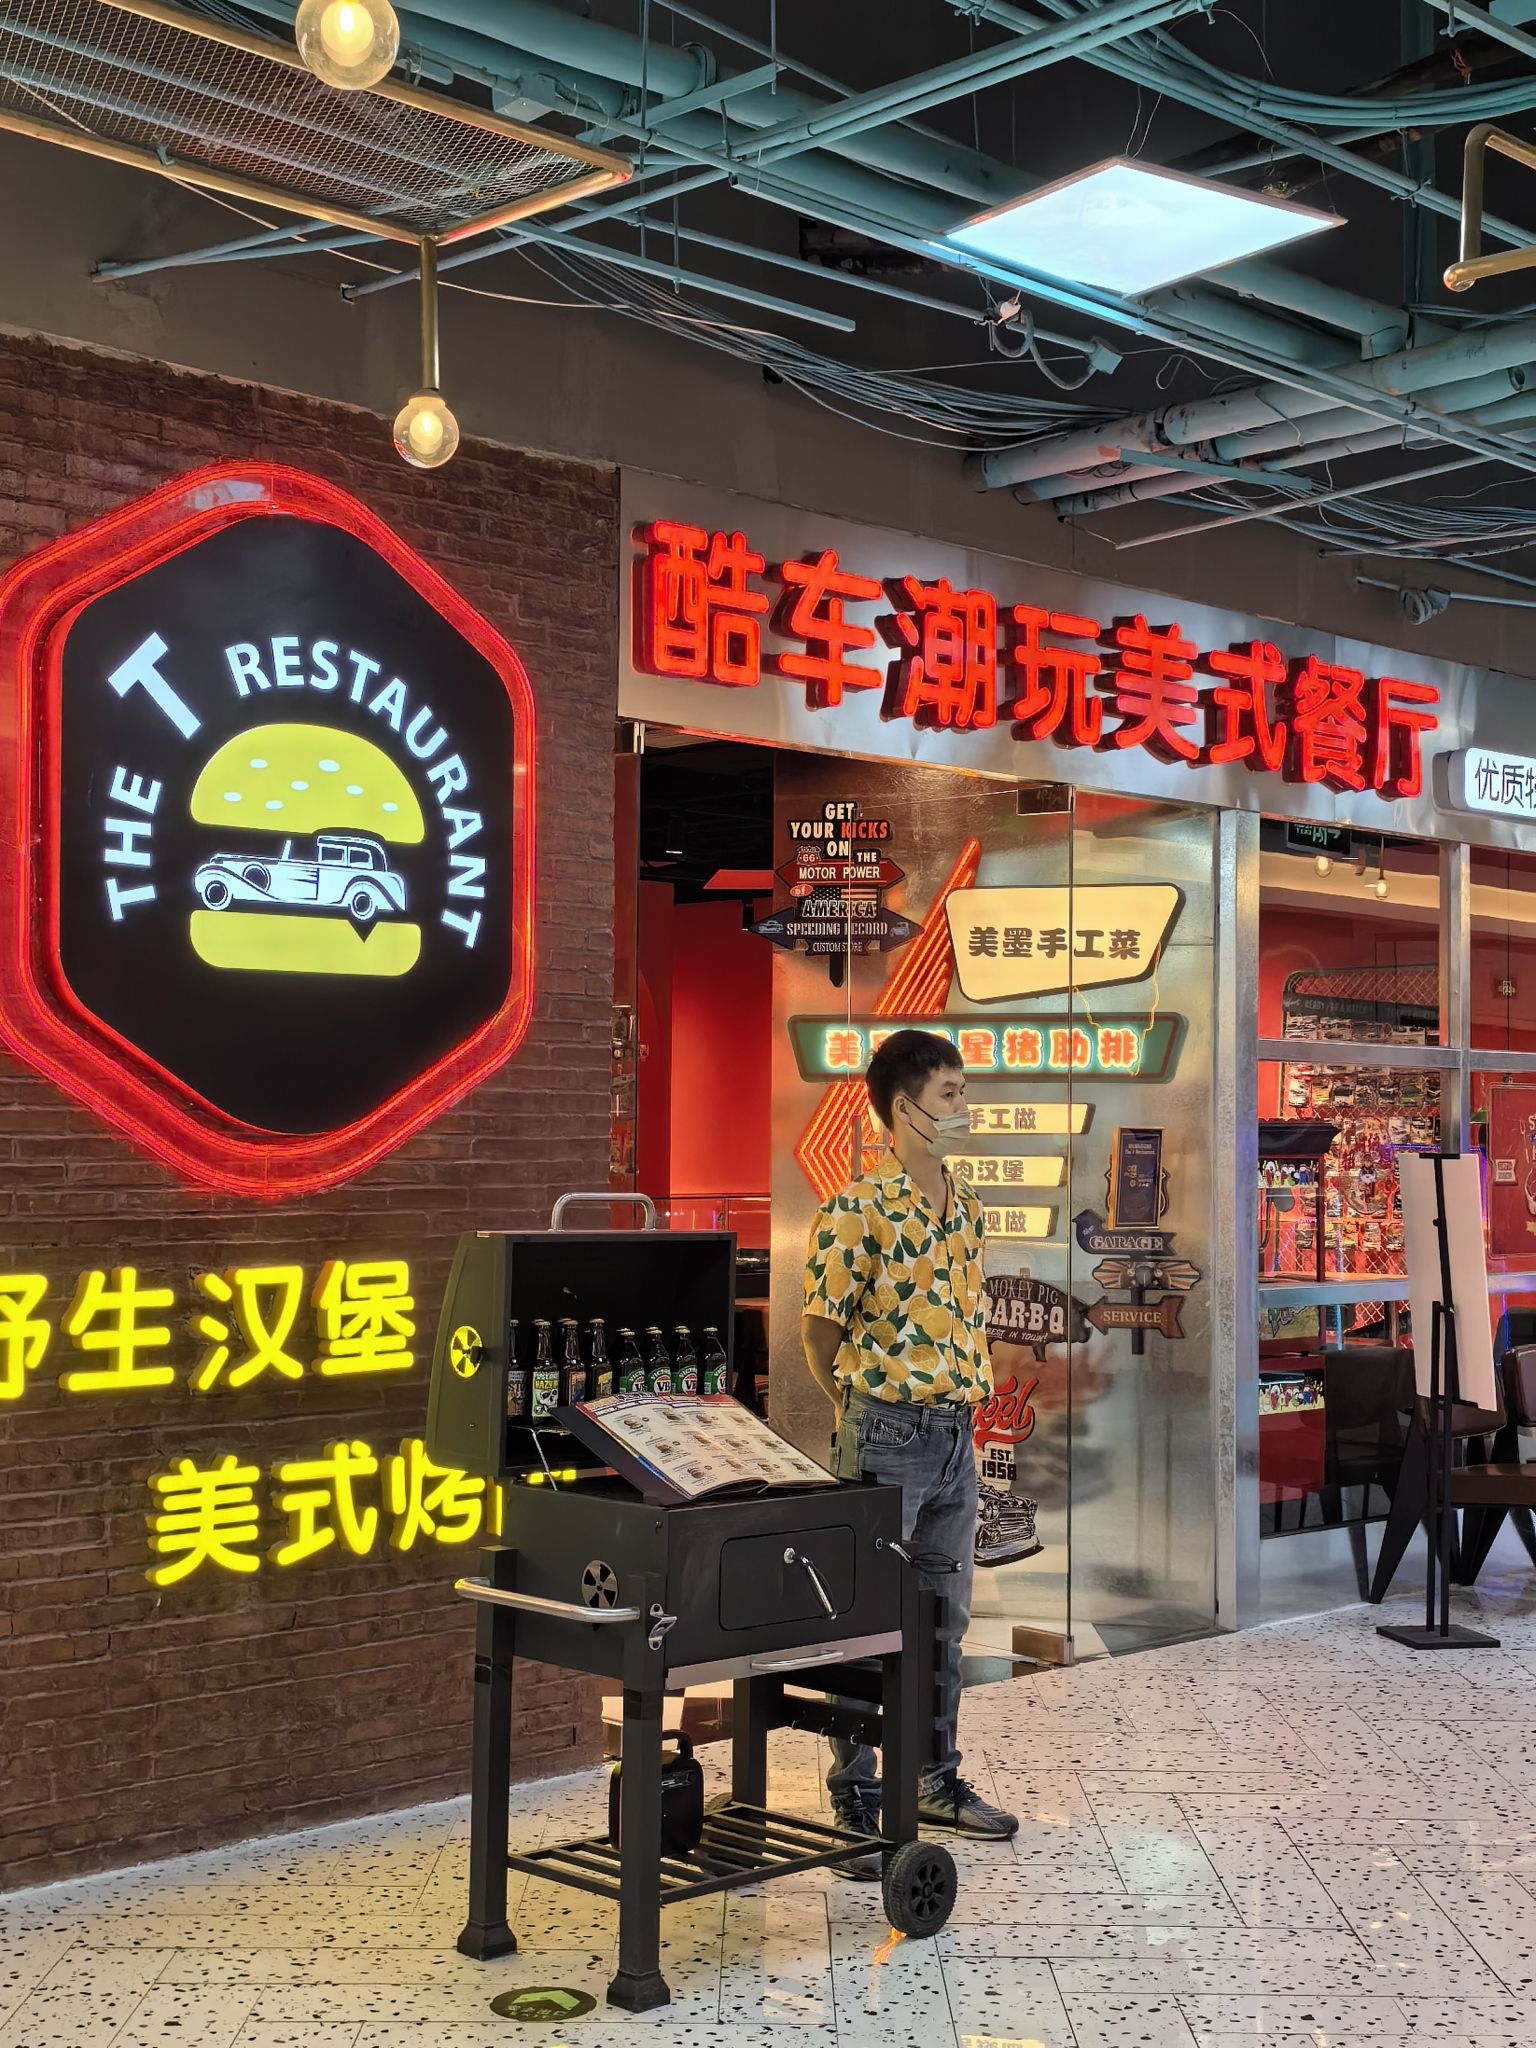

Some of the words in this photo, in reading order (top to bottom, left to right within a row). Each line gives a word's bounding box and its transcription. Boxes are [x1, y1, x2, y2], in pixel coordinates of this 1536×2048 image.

[634, 519, 1440, 798] 酷车潮玩美式餐厅
[107, 632, 200, 739] T
[224, 636, 487, 948] RESTAURANT
[825, 803, 854, 819] GET
[791, 822, 834, 838] YOUR
[841, 822, 888, 838] KICKS
[102, 765, 163, 922] THE
[826, 841, 849, 857] ON
[802, 853, 816, 862] 66
[857, 852, 877, 862] THE
[799, 866, 836, 879] MOTOR
[842, 866, 880, 879] POWER
[802, 899, 877, 918] AMERICA
[786, 922, 840, 935] SPEEDING
[812, 942, 840, 952] CUSTOM
[842, 943, 863, 952] SORE
[968, 927, 1142, 961] 美墨手工菜
[824, 1028, 1140, 1070] 美星猪肋排
[1089, 1235, 1163, 1250] GARAGE
[989, 1279, 1033, 1300] MOKEY
[1038, 1284, 1058, 1305] PIG
[1103, 1310, 1161, 1323] SERVICE
[1009, 1331, 1018, 1339] IN
[991, 1449, 1013, 1461] EST.
[982, 1460, 1016, 1481] 1958
[150, 1438, 503, 1587] 美式烤
